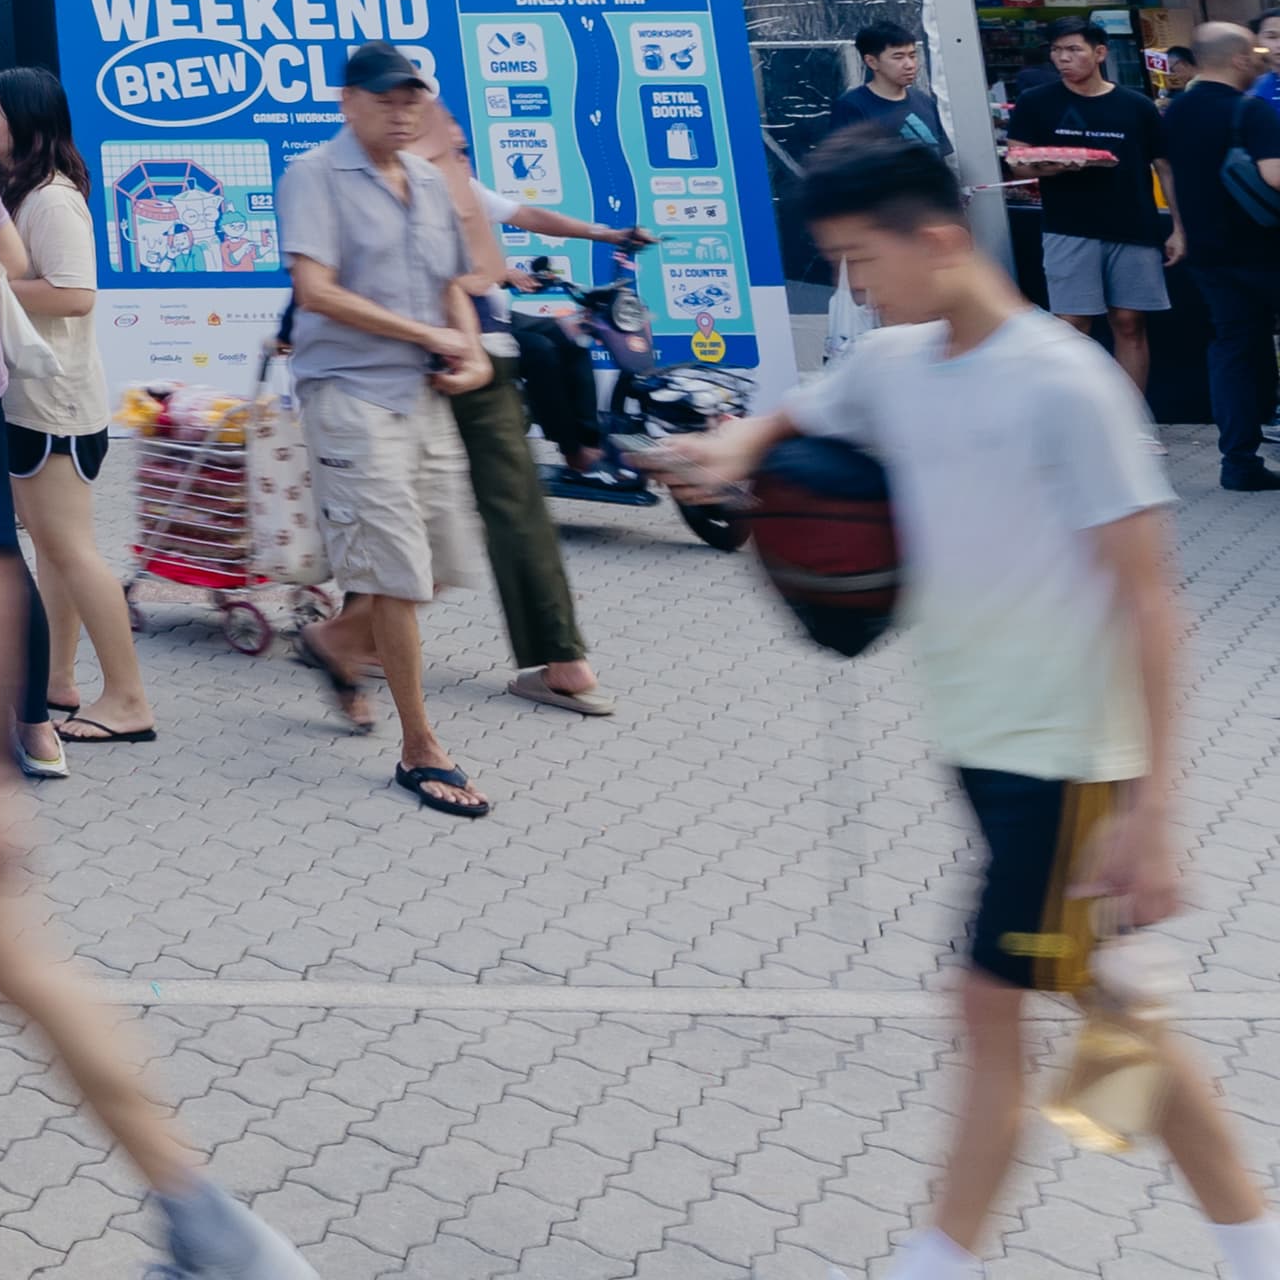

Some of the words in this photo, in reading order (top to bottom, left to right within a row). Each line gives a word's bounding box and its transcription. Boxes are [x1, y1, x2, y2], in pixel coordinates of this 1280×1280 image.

[637, 29, 694, 38] WORKSHOPS
[490, 61, 538, 73] GAMES
[114, 52, 247, 106] BREW
[264, 44, 440, 103] CLB
[652, 91, 699, 105] RETAIL
[651, 105, 703, 119] BOOTHS
[295, 112, 346, 123] WORKSHO
[507, 129, 536, 138] BREW
[1085, 130, 1125, 139] EXCHANGE
[499, 139, 548, 149] STATIONS
[670, 269, 682, 278] DJ
[685, 269, 728, 278] COUNTER
